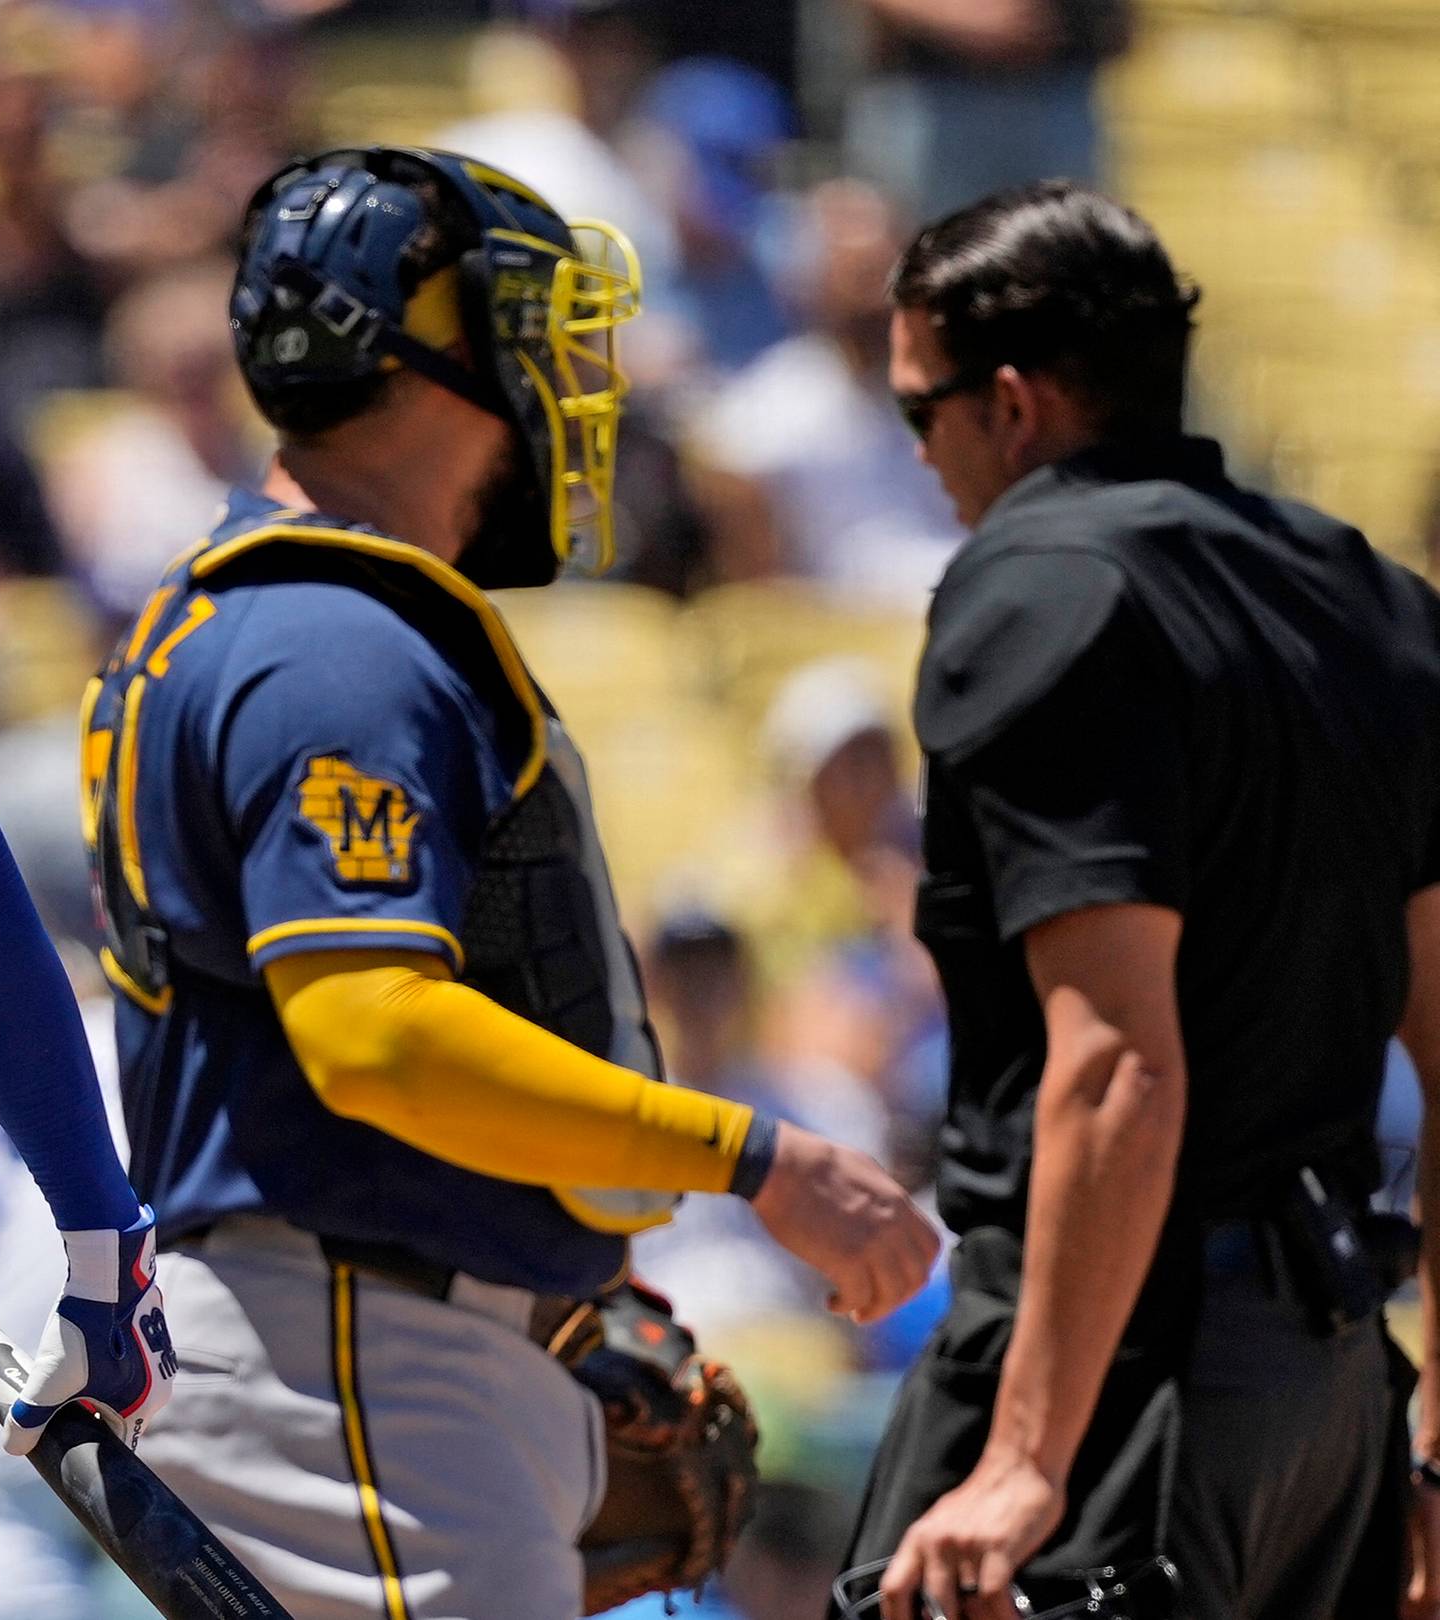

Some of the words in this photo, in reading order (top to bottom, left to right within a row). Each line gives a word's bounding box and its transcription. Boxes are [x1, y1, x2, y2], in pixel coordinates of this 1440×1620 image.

[338, 785, 395, 854] M
[192, 1556, 222, 1588] SHOHEI
[219, 1583, 249, 1617] OHTANI
